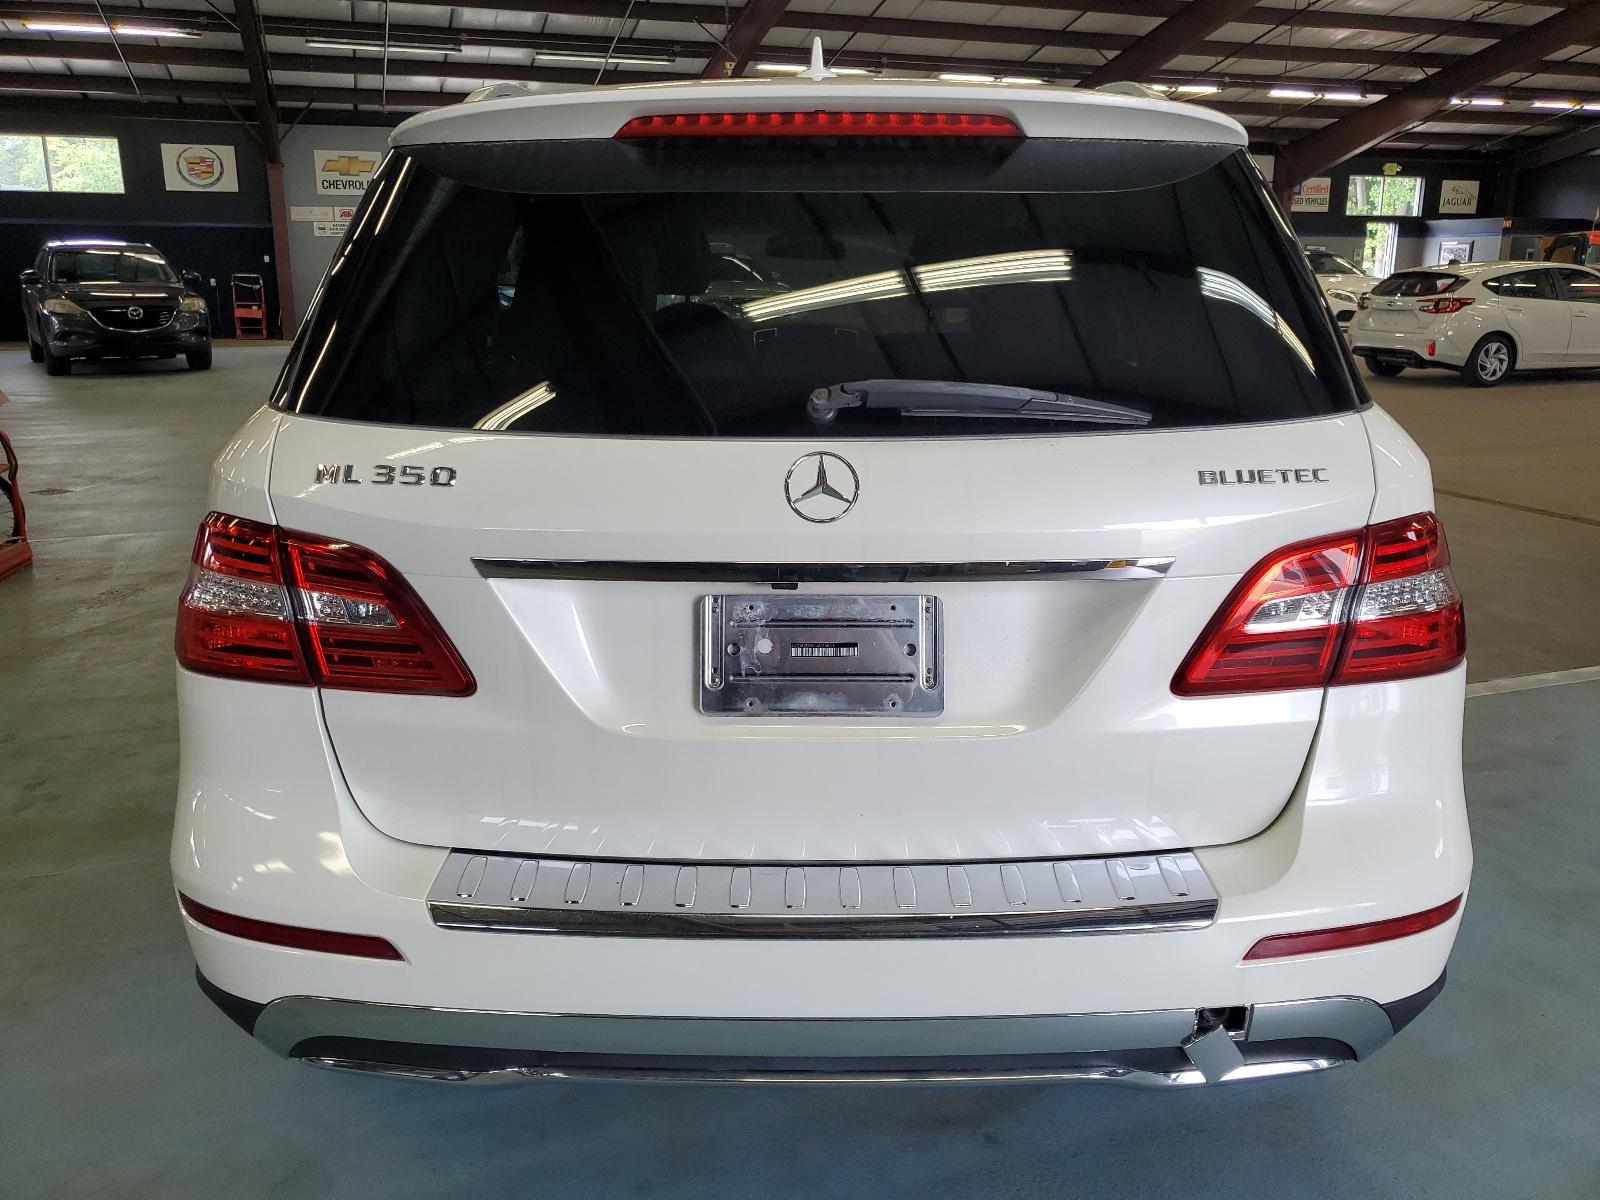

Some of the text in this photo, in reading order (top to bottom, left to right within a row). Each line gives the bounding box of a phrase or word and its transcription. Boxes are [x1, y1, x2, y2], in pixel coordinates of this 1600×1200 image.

[1442, 197, 1472, 207] JAGUAR
[315, 464, 457, 487] ML 350
[1198, 468, 1330, 486] BLUETEC
